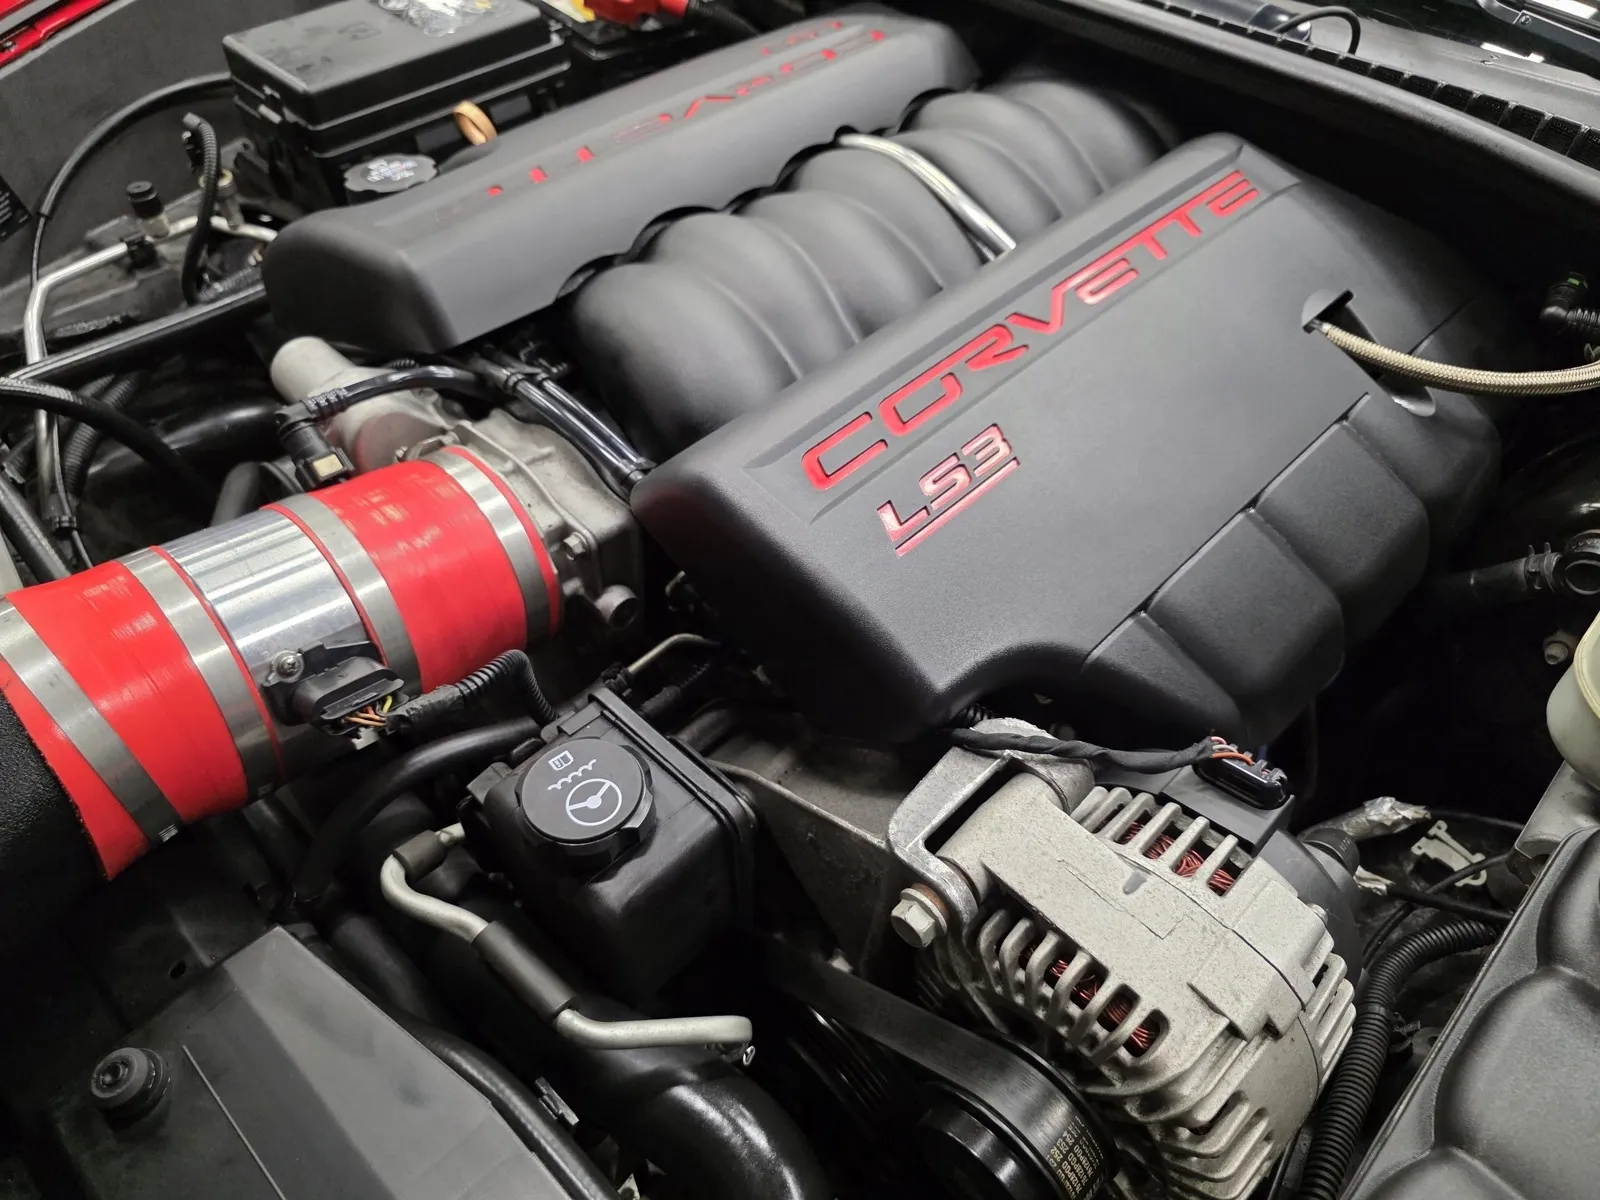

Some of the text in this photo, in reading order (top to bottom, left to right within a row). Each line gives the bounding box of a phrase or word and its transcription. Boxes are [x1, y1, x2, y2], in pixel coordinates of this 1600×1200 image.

[801, 169, 1260, 491] CORVETTE
[876, 423, 1013, 543] LS3
[1056, 1138, 1069, 1154] 253
[1062, 1130, 1075, 1146] 254
[1050, 1146, 1063, 1162] 252
